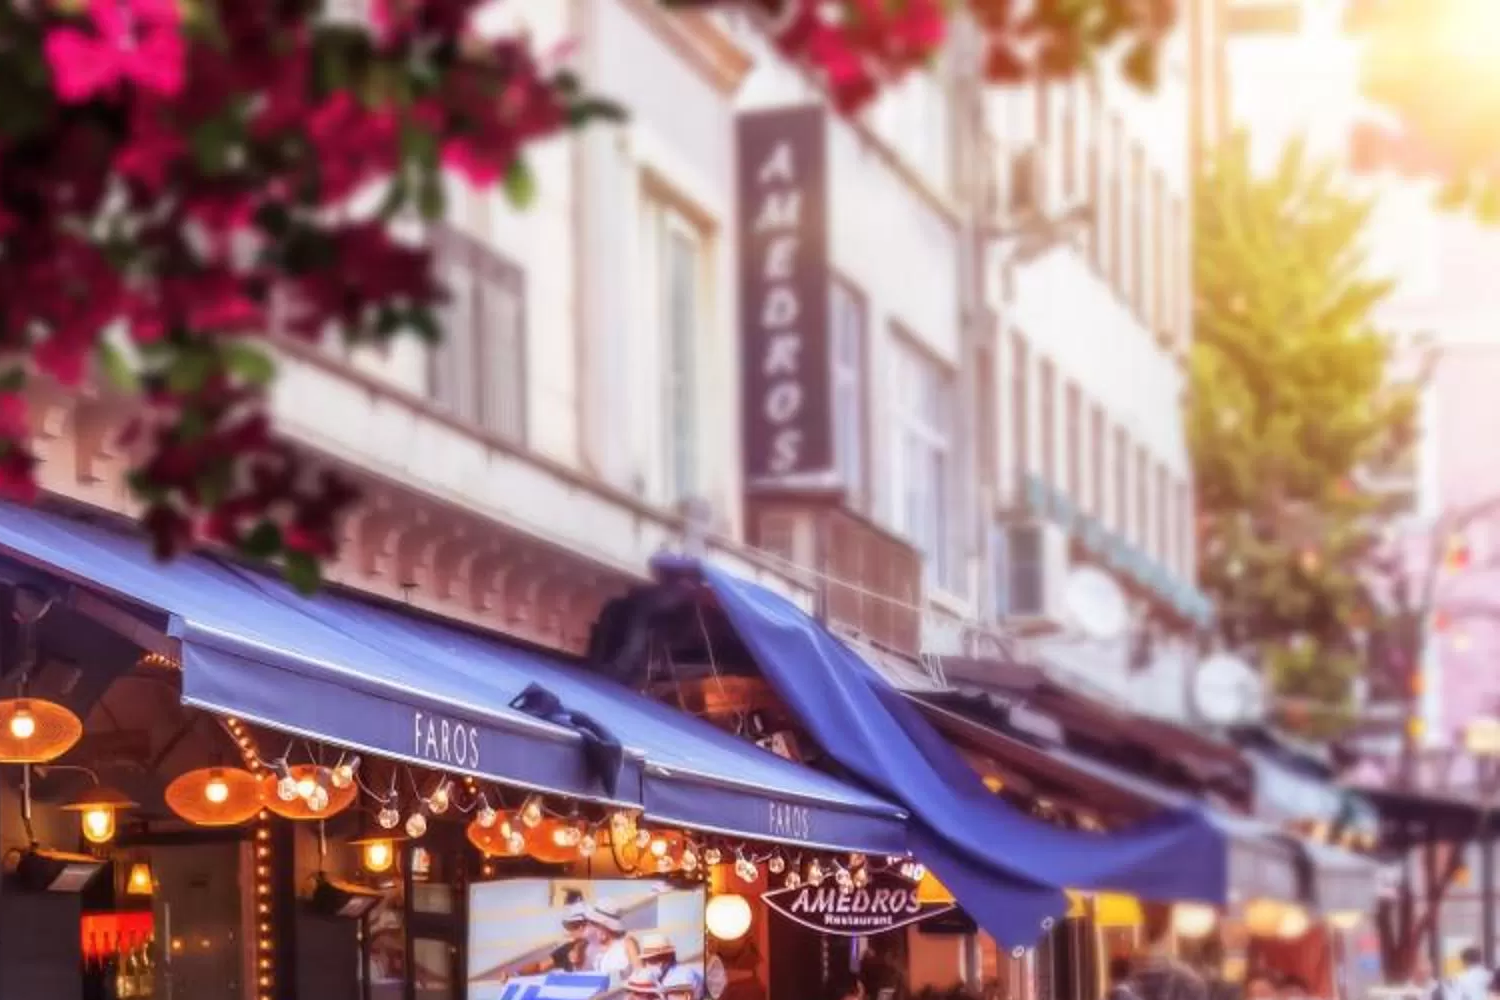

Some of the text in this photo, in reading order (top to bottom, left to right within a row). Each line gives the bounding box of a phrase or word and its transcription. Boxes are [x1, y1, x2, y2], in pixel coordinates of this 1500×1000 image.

[415, 712, 479, 769] FAROS
[791, 887, 921, 913] AMEDROS
[824, 914, 893, 926] Restaurant
